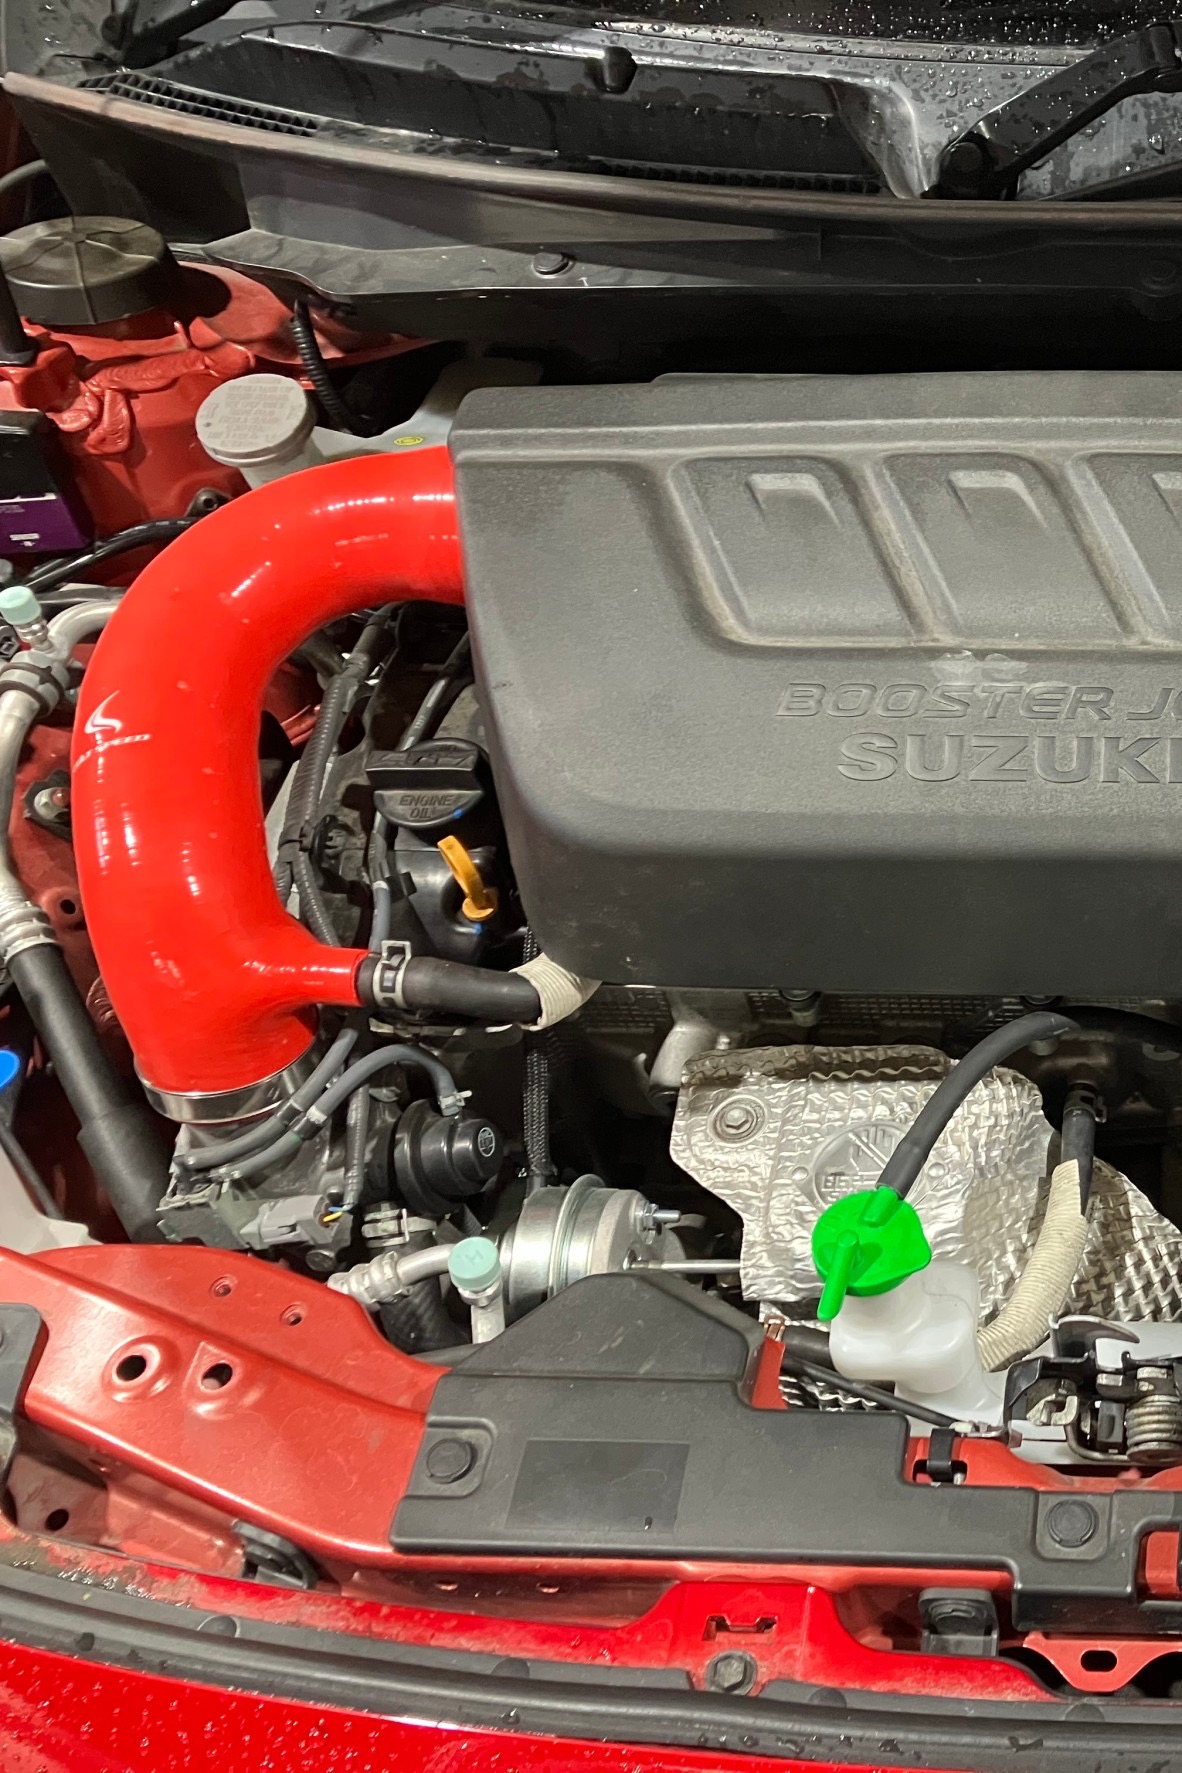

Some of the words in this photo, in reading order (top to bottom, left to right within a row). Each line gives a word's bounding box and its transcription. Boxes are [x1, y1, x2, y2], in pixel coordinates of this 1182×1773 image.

[775, 682, 1114, 721] BOOSTER
[399, 794, 455, 806] ENGINE
[409, 807, 432, 819] OIL
